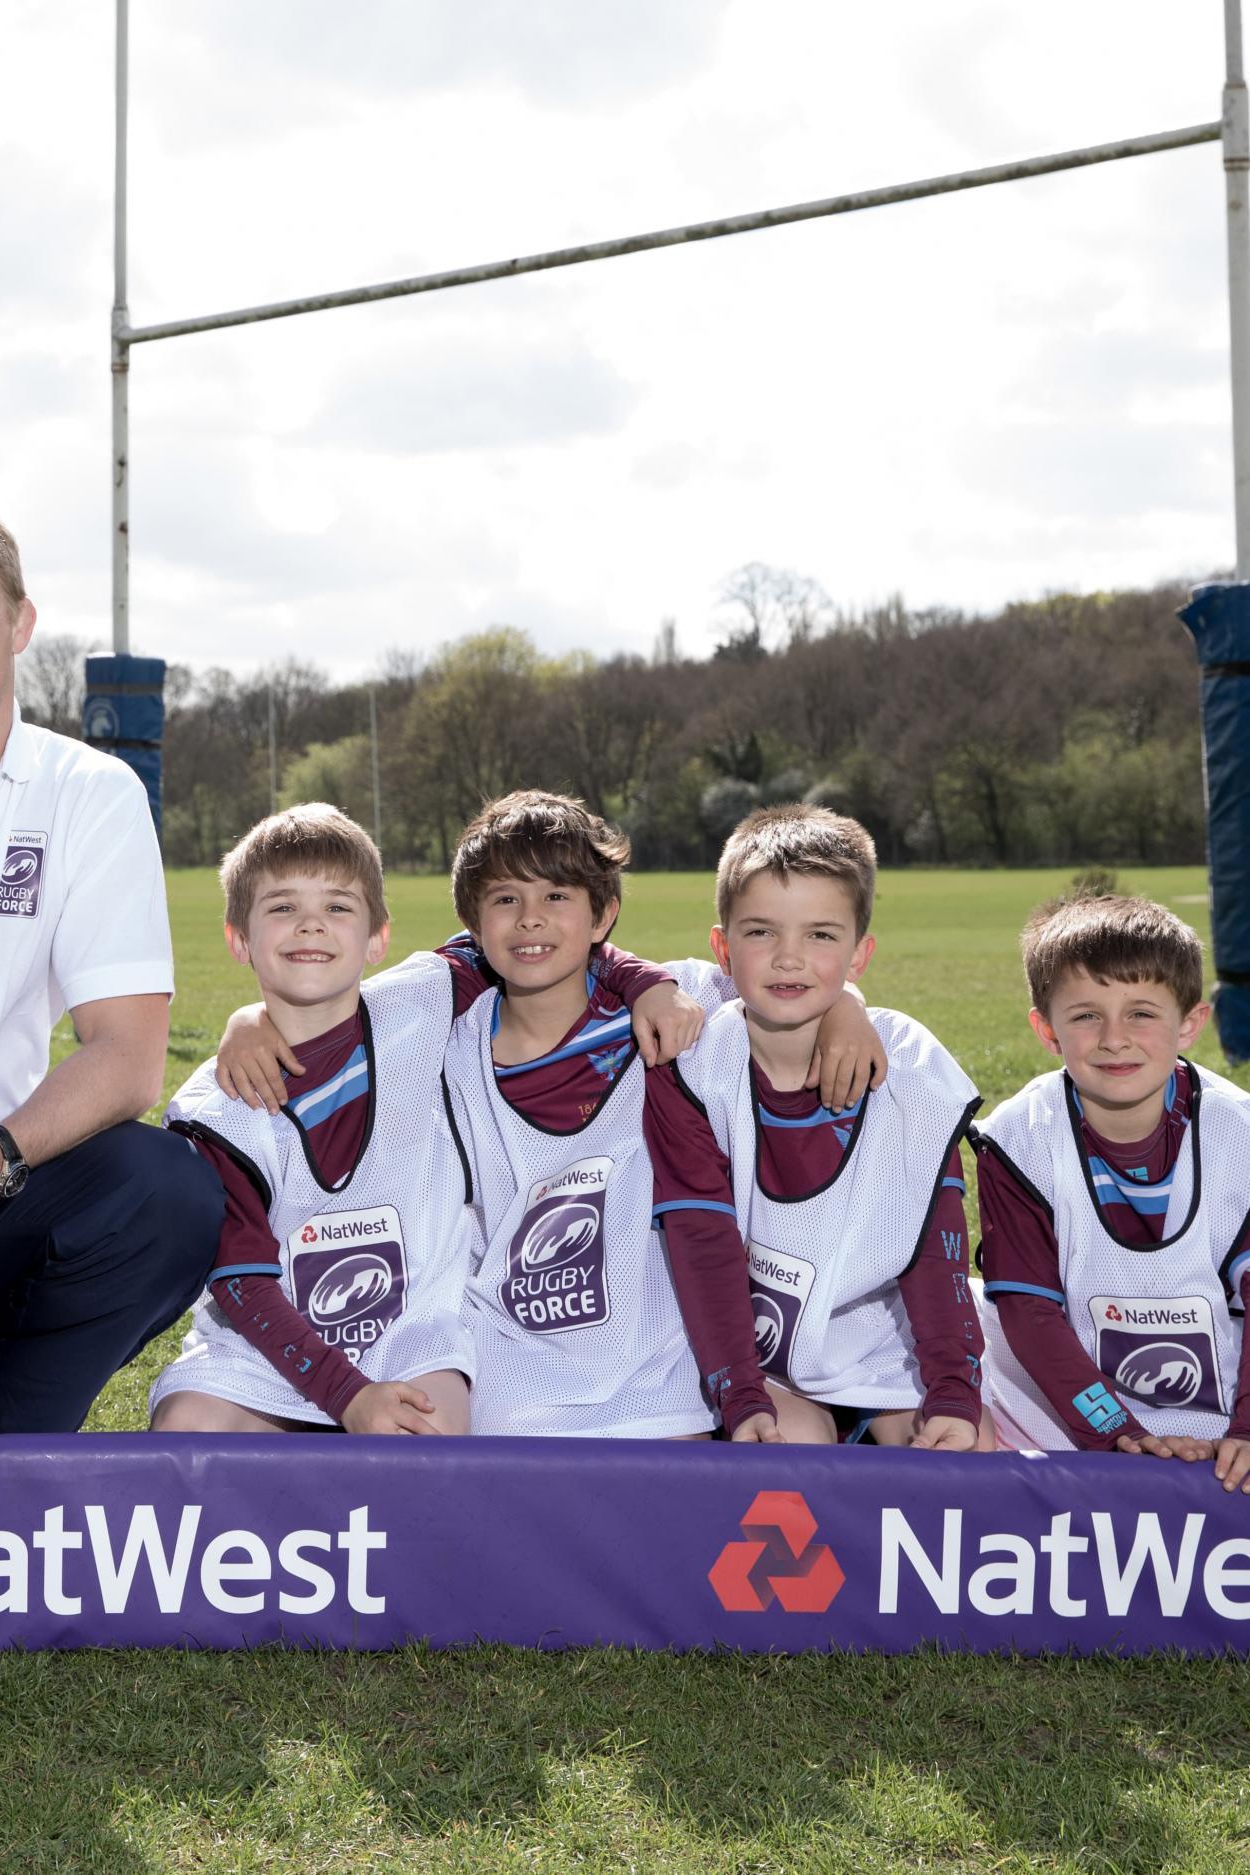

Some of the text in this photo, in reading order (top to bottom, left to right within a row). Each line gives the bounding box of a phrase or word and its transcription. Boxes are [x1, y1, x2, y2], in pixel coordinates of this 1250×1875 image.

[13, 835, 42, 844] NatWest
[549, 1169, 603, 1191] NatWest
[321, 1218, 389, 1241] NatWest
[510, 1265, 595, 1299] RUGBY
[750, 1254, 801, 1286] NatWest
[515, 1290, 596, 1324] FORCE
[1125, 1309, 1198, 1324] NatWest
[317, 1317, 393, 1346] UGBY
[878, 1507, 1250, 1620] NatWe
